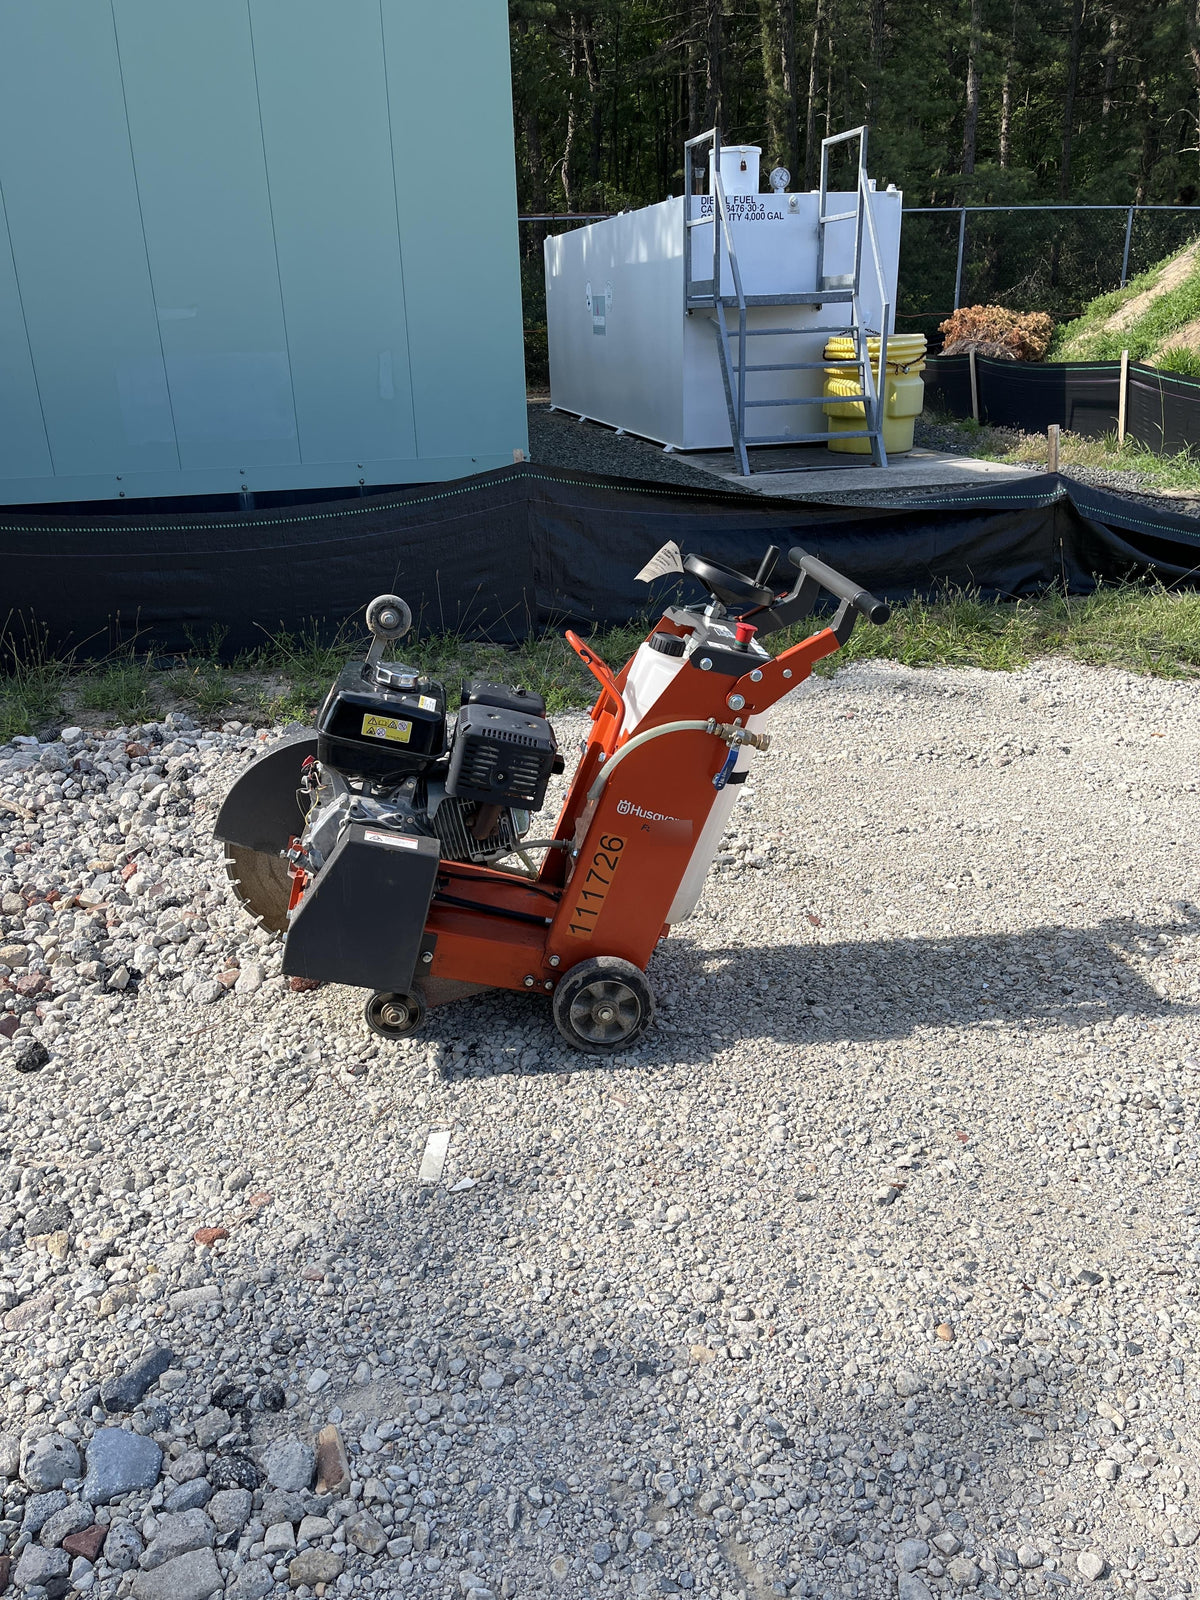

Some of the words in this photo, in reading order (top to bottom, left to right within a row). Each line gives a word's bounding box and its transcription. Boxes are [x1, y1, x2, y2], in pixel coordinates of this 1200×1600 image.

[701, 196, 730, 205] DIEL
[733, 196, 756, 204] FUEL
[744, 212, 766, 221] 4,000
[767, 211, 784, 220] GAL
[568, 835, 624, 933] 111726
